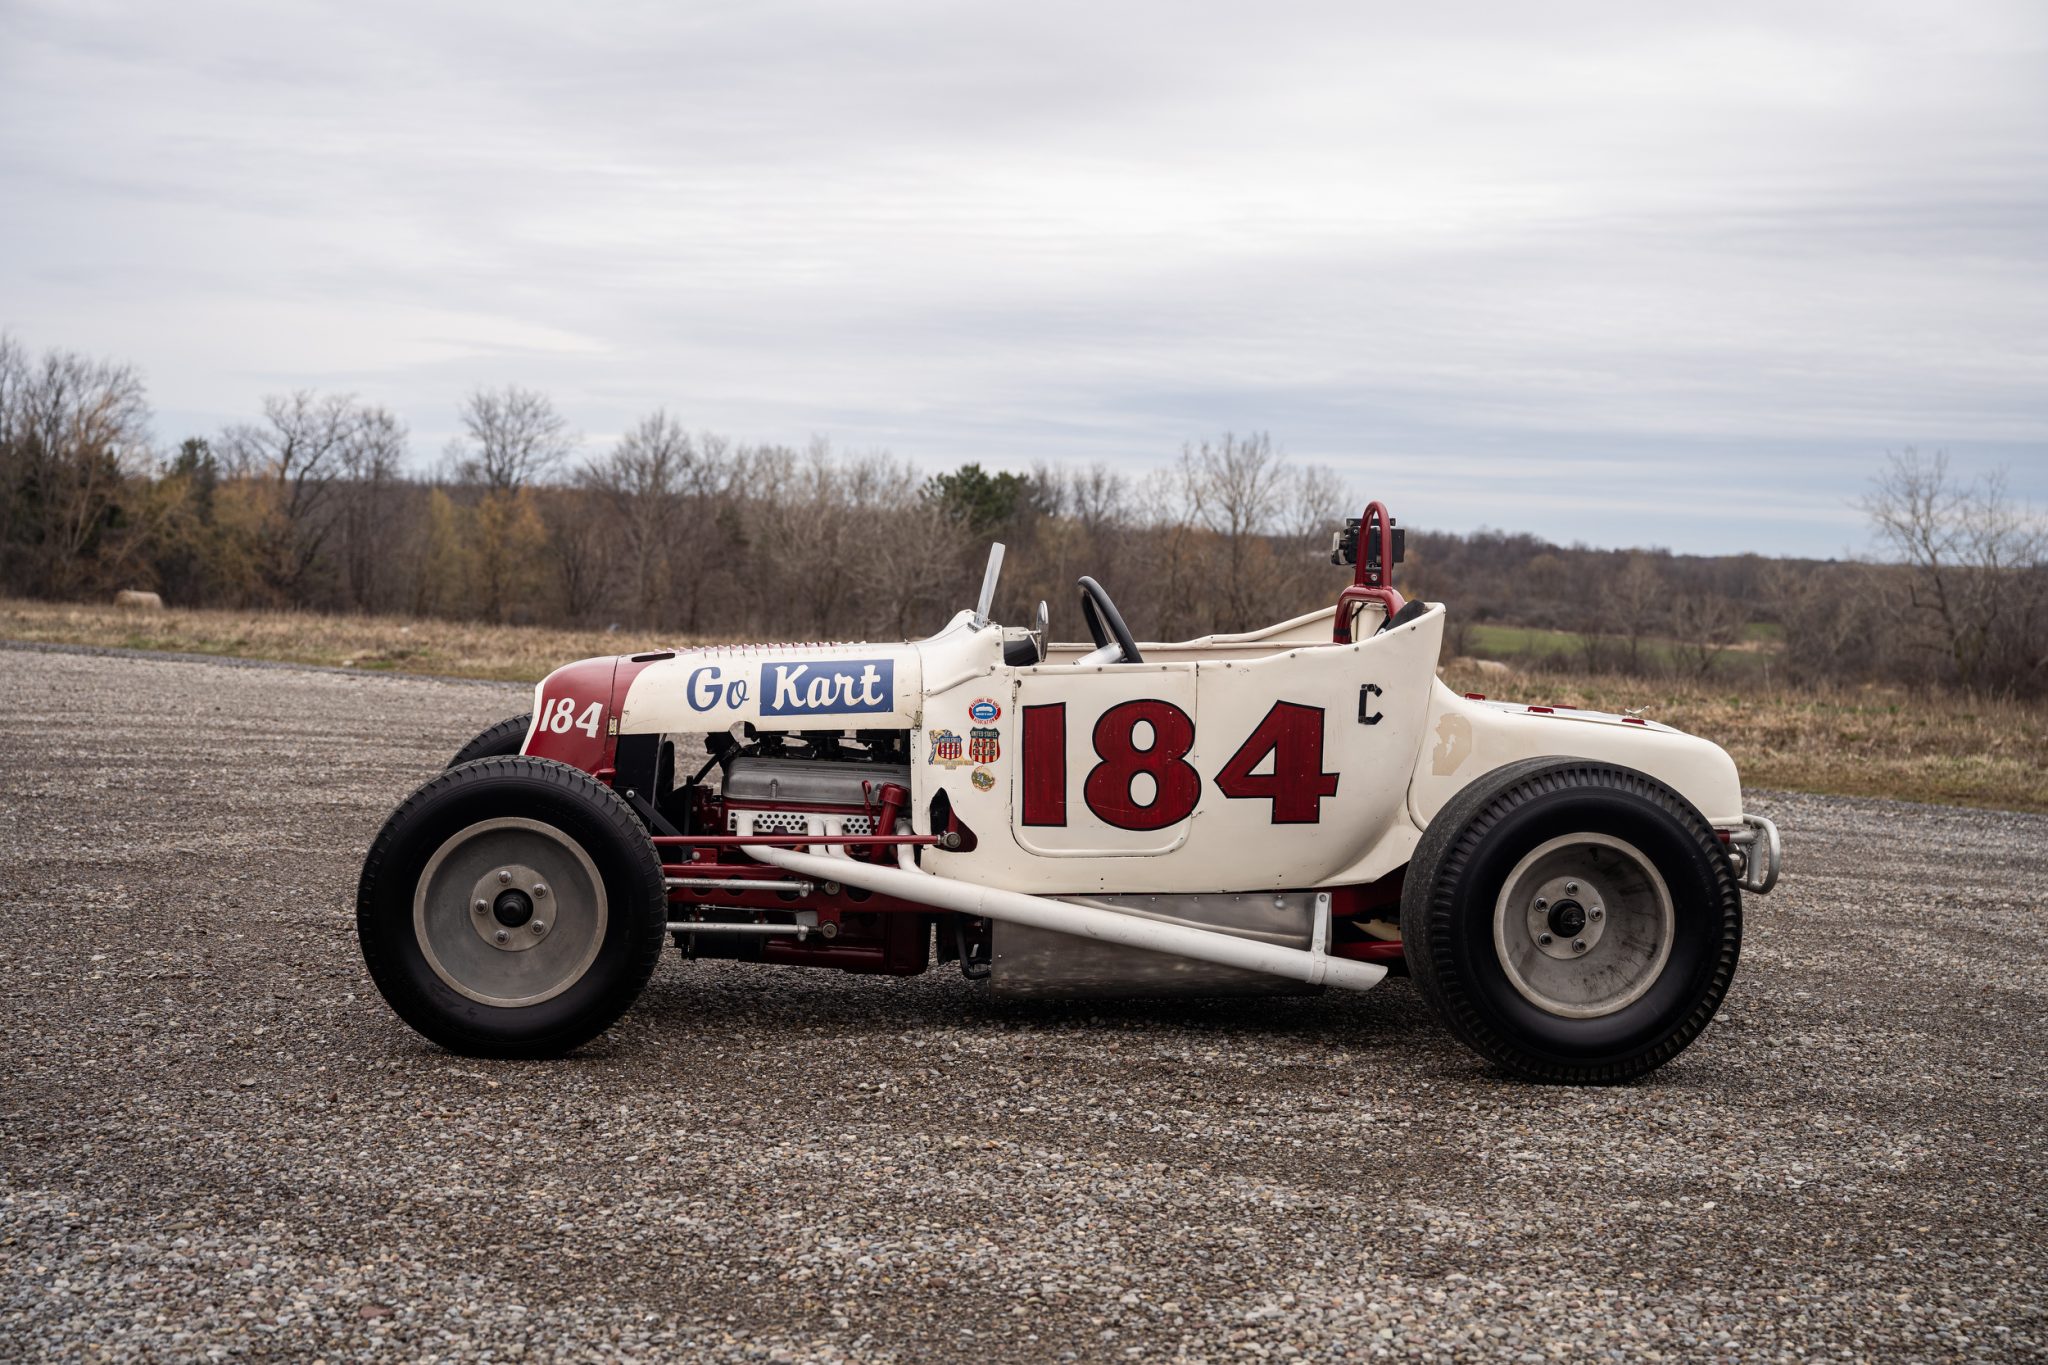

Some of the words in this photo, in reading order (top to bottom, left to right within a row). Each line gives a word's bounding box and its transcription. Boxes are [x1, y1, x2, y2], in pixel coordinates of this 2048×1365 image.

[686, 665, 750, 713] Go
[771, 663, 884, 711] Kart
[1357, 683, 1384, 726] C
[538, 697, 604, 739] 184
[972, 741, 996, 749] AUTO
[1021, 698, 1341, 831] 184
